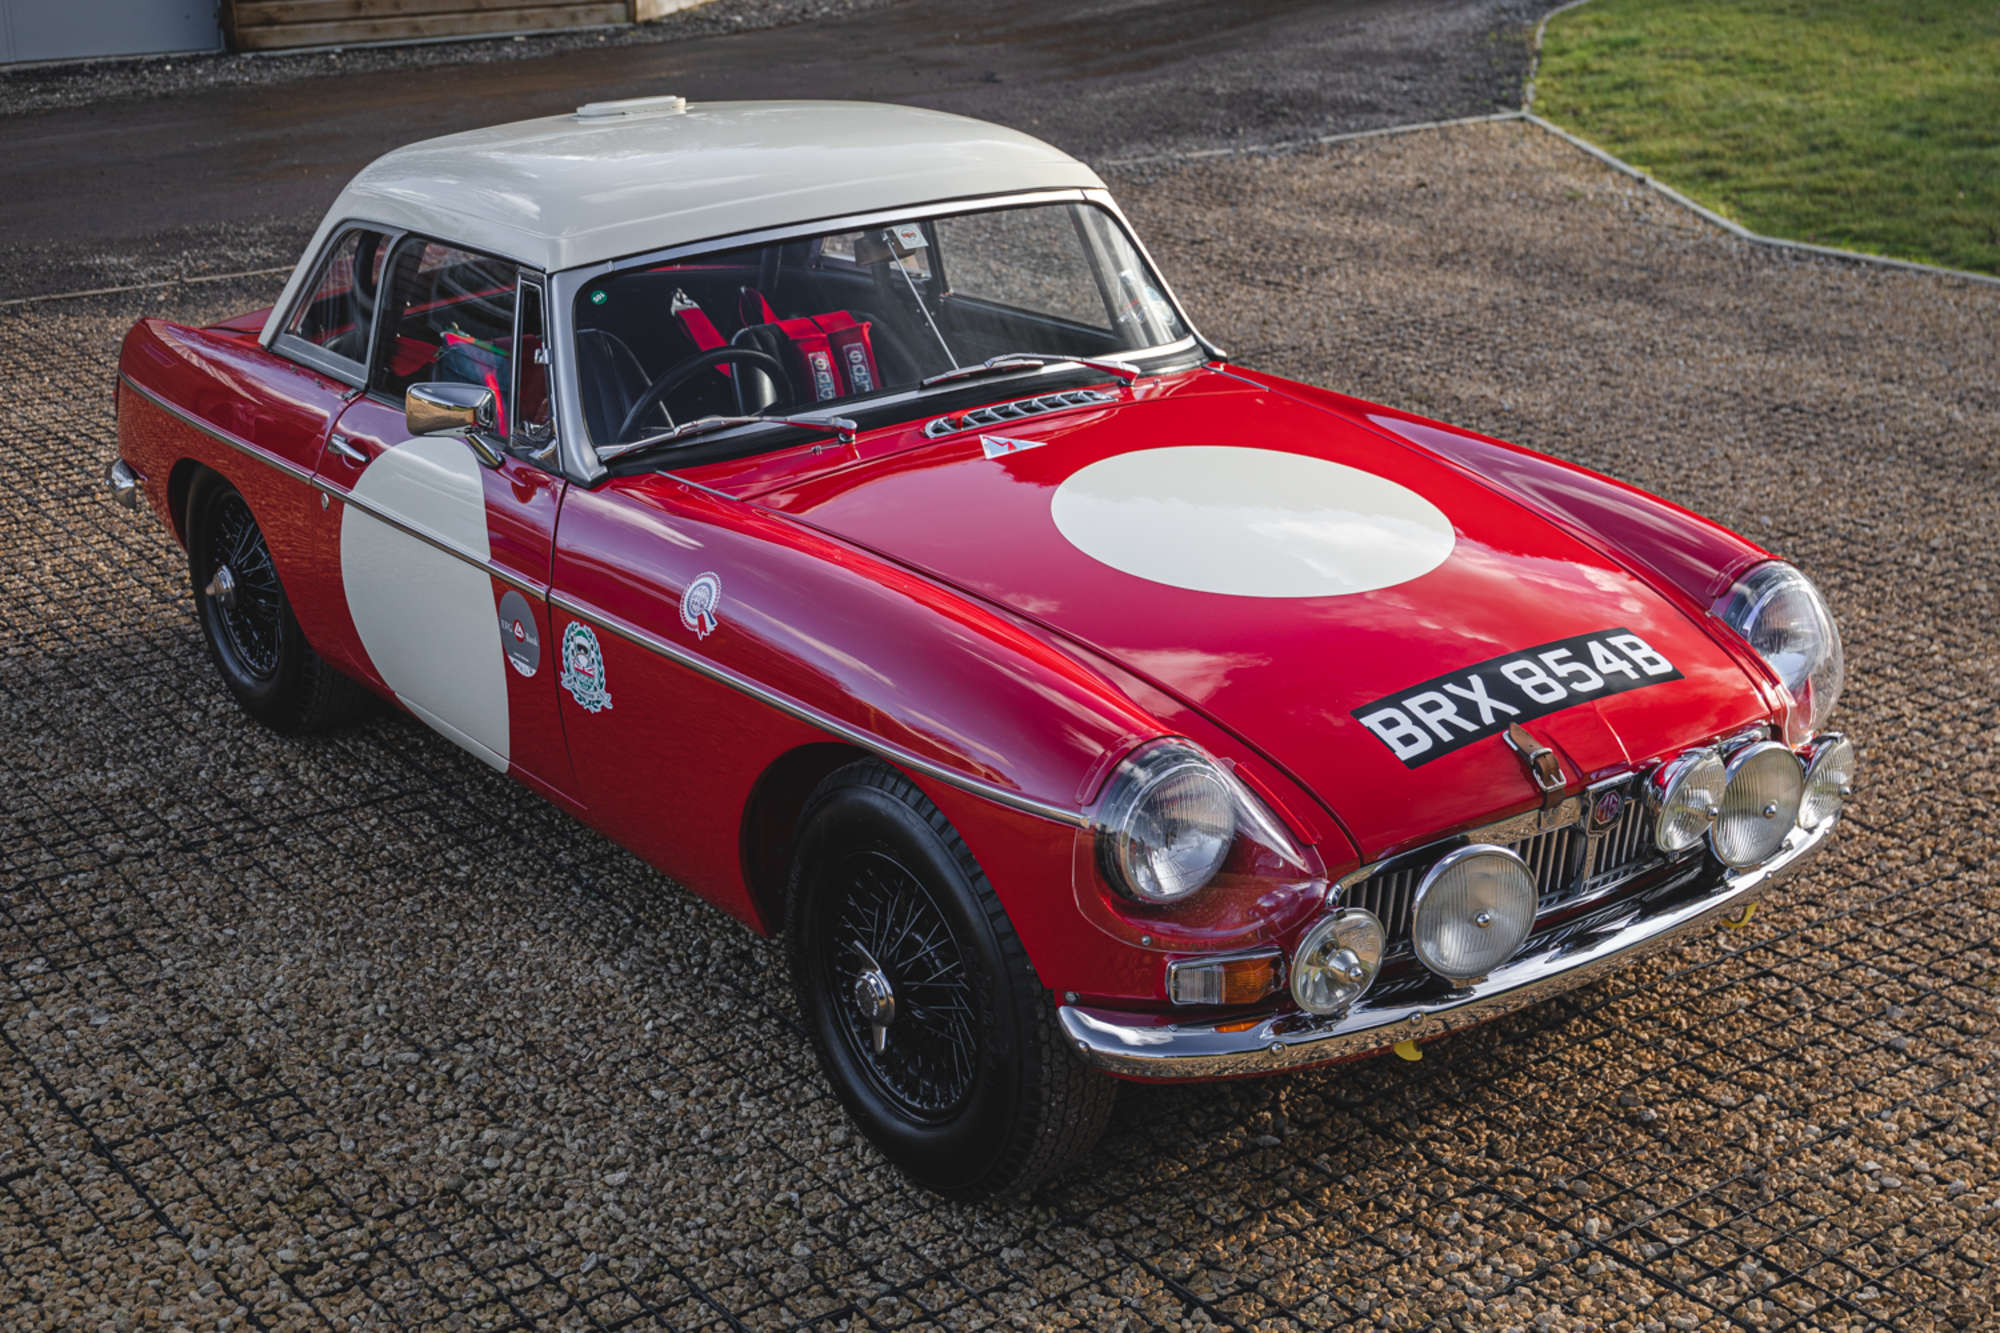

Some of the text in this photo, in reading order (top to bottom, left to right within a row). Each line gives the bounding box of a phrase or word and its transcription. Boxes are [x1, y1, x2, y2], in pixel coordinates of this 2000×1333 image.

[1359, 634, 1674, 762] BRX 854B
[1596, 793, 1618, 820] MG
